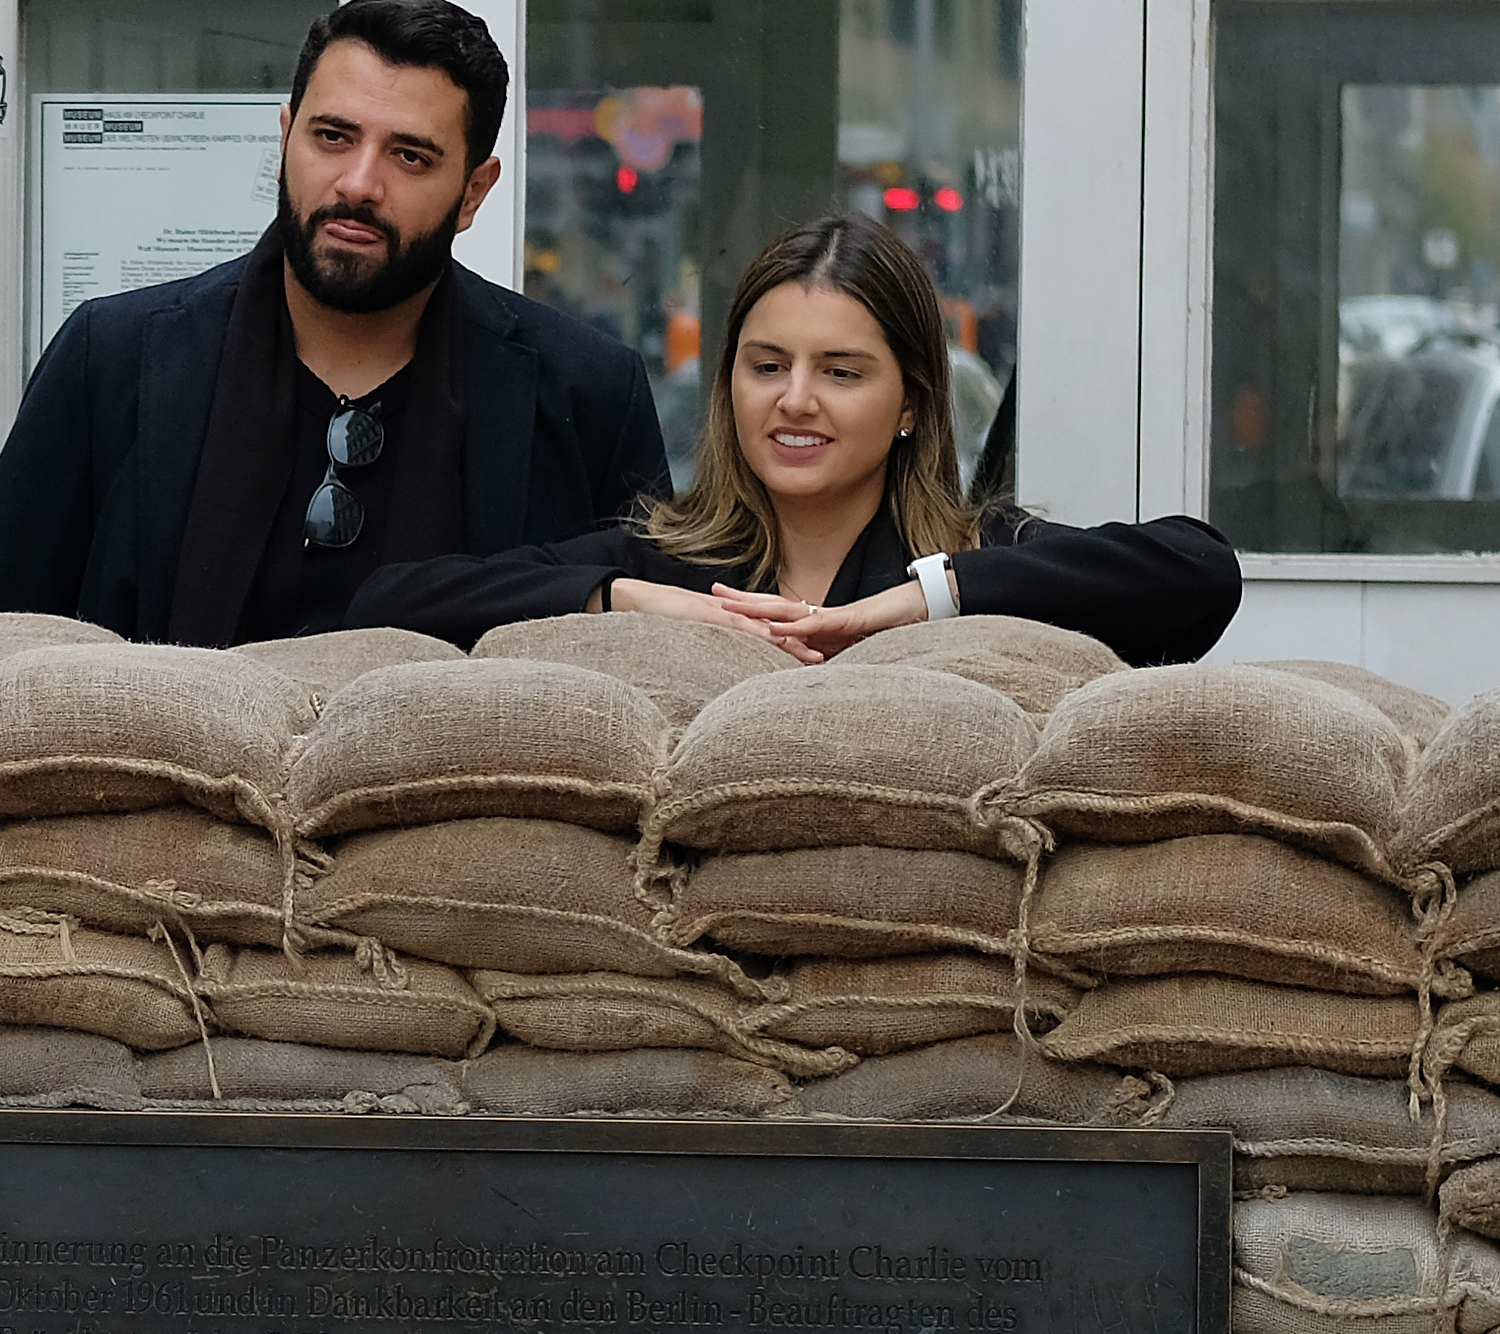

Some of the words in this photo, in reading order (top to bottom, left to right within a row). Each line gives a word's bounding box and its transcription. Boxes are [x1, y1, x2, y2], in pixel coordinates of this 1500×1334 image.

[156, 1243, 197, 1268] an
[204, 1234, 252, 1269] die
[260, 1235, 587, 1278] Panzerkonfrontation
[595, 1248, 647, 1276] am
[655, 1243, 841, 1288] Checkpoint
[849, 1245, 967, 1282] Charlie
[978, 1255, 1044, 1283] vom
[122, 1280, 187, 1315] 1961
[194, 1283, 257, 1317] und
[265, 1283, 296, 1317] in
[307, 1283, 510, 1322] Dankbarkeit
[512, 1294, 551, 1321] an
[560, 1287, 618, 1324] den
[970, 1297, 1018, 1332] des
